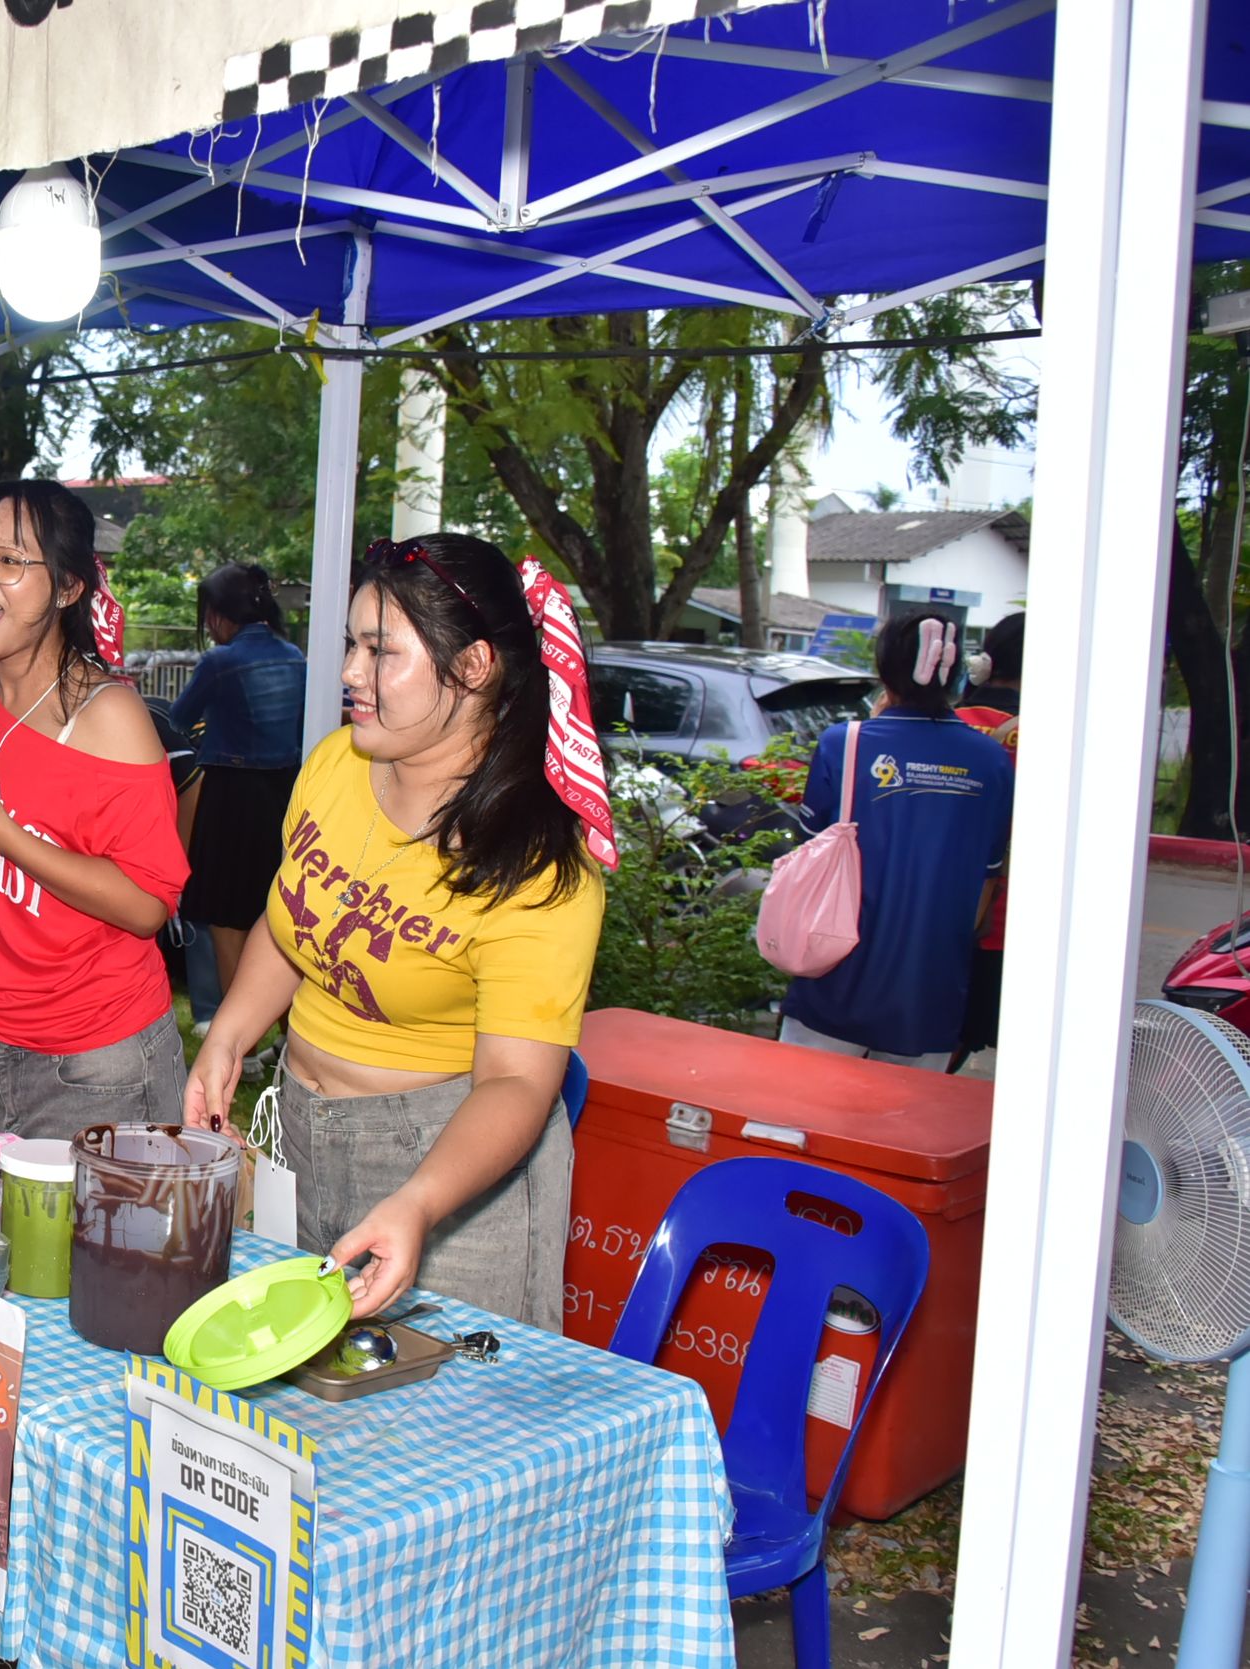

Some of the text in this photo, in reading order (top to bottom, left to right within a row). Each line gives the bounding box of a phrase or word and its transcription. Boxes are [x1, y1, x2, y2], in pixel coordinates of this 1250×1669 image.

[541, 637, 570, 664] ASTE
[569, 737, 602, 766] TASTE
[564, 786, 612, 828] TID TASTE
[171, 1432, 270, 1498] ช่องทางการชำระเงิน
[180, 1462, 260, 1523] QR CODE
